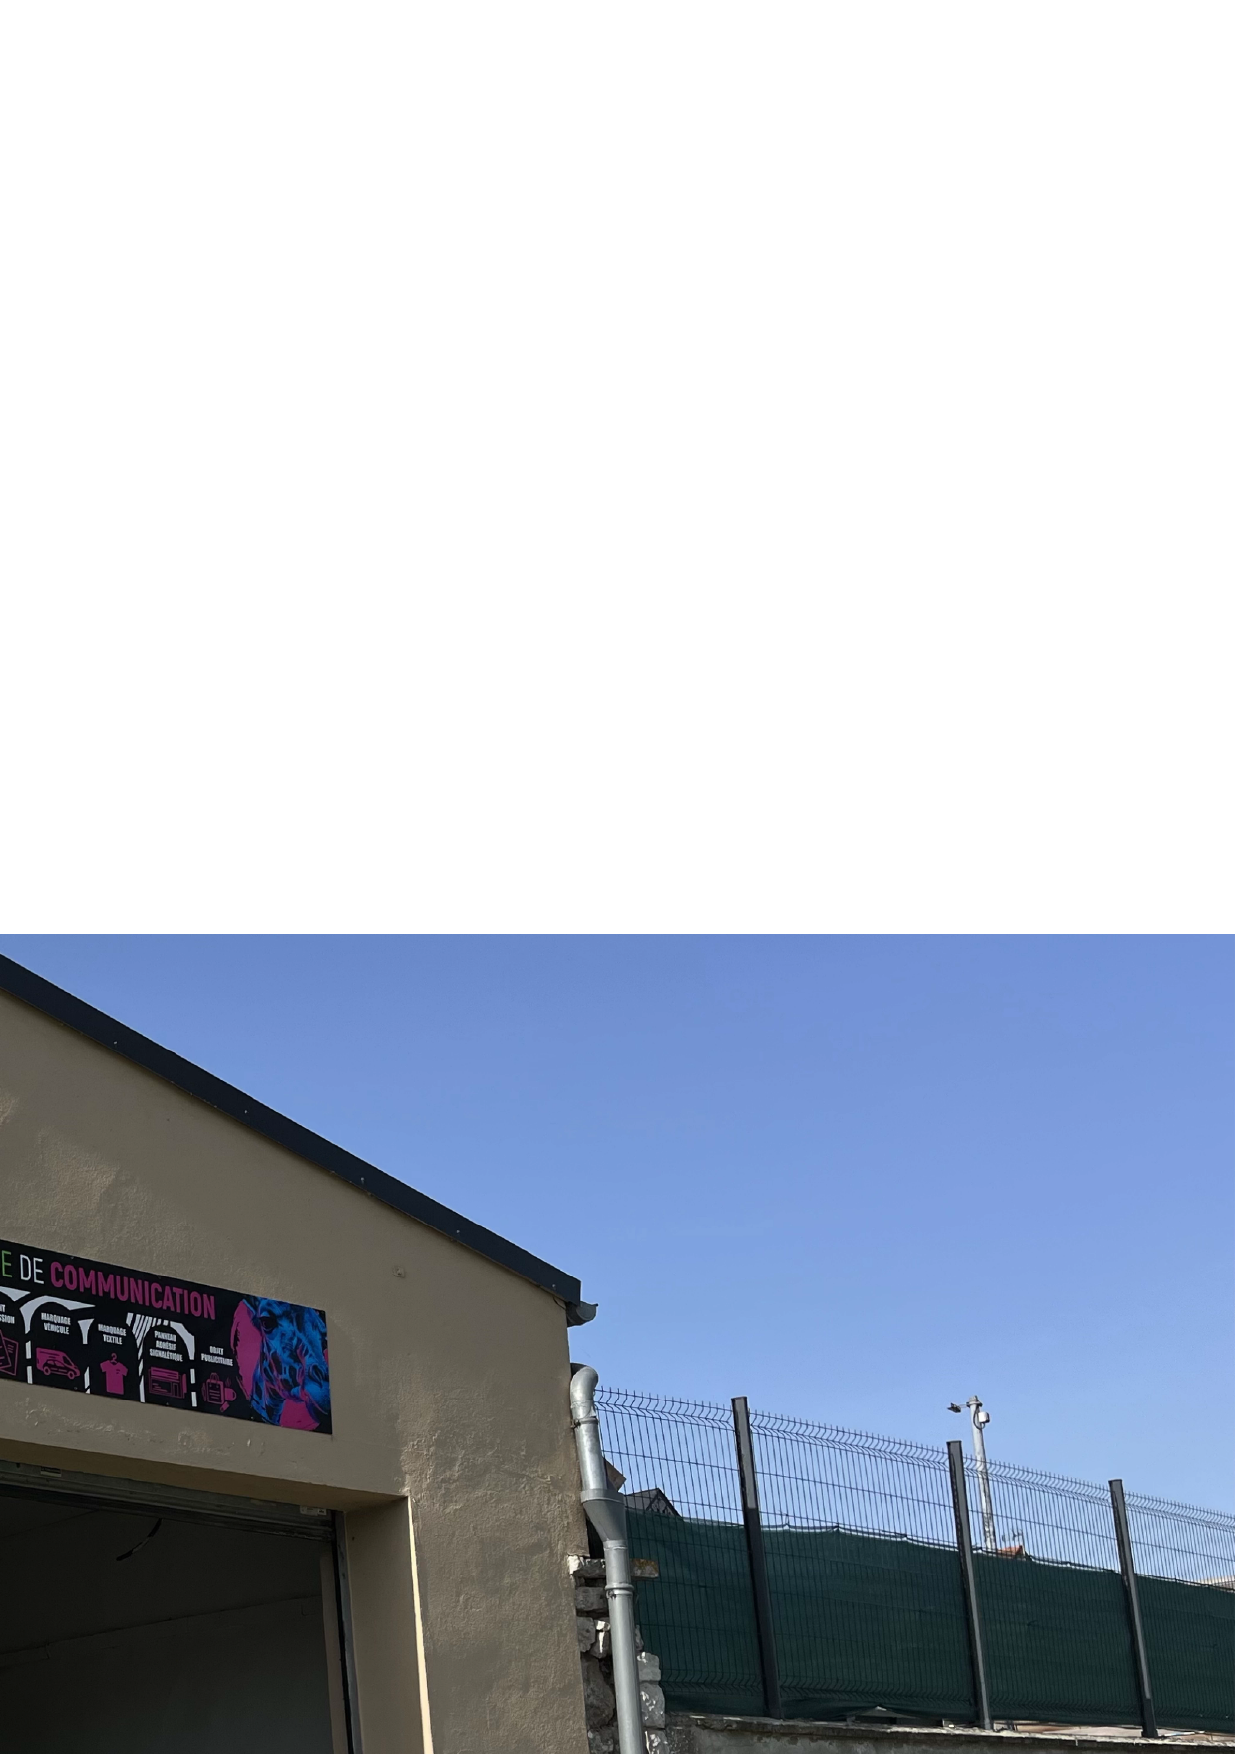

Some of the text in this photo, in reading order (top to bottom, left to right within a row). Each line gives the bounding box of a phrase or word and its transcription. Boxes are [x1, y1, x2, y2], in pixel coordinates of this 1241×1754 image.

[19, 1254, 44, 1284] DE
[50, 1261, 216, 1320] COMMUNICATION
[41, 1312, 71, 1325] MARQUAGE
[43, 1322, 70, 1334] VÉHICULE
[98, 1324, 126, 1336] MARQUAGE
[102, 1334, 123, 1345] TEXTILE
[154, 1330, 177, 1342] PANNEAU
[149, 1348, 183, 1362] SIGNALÉTIQUE
[200, 1353, 233, 1366] PUBLICITAIRE
